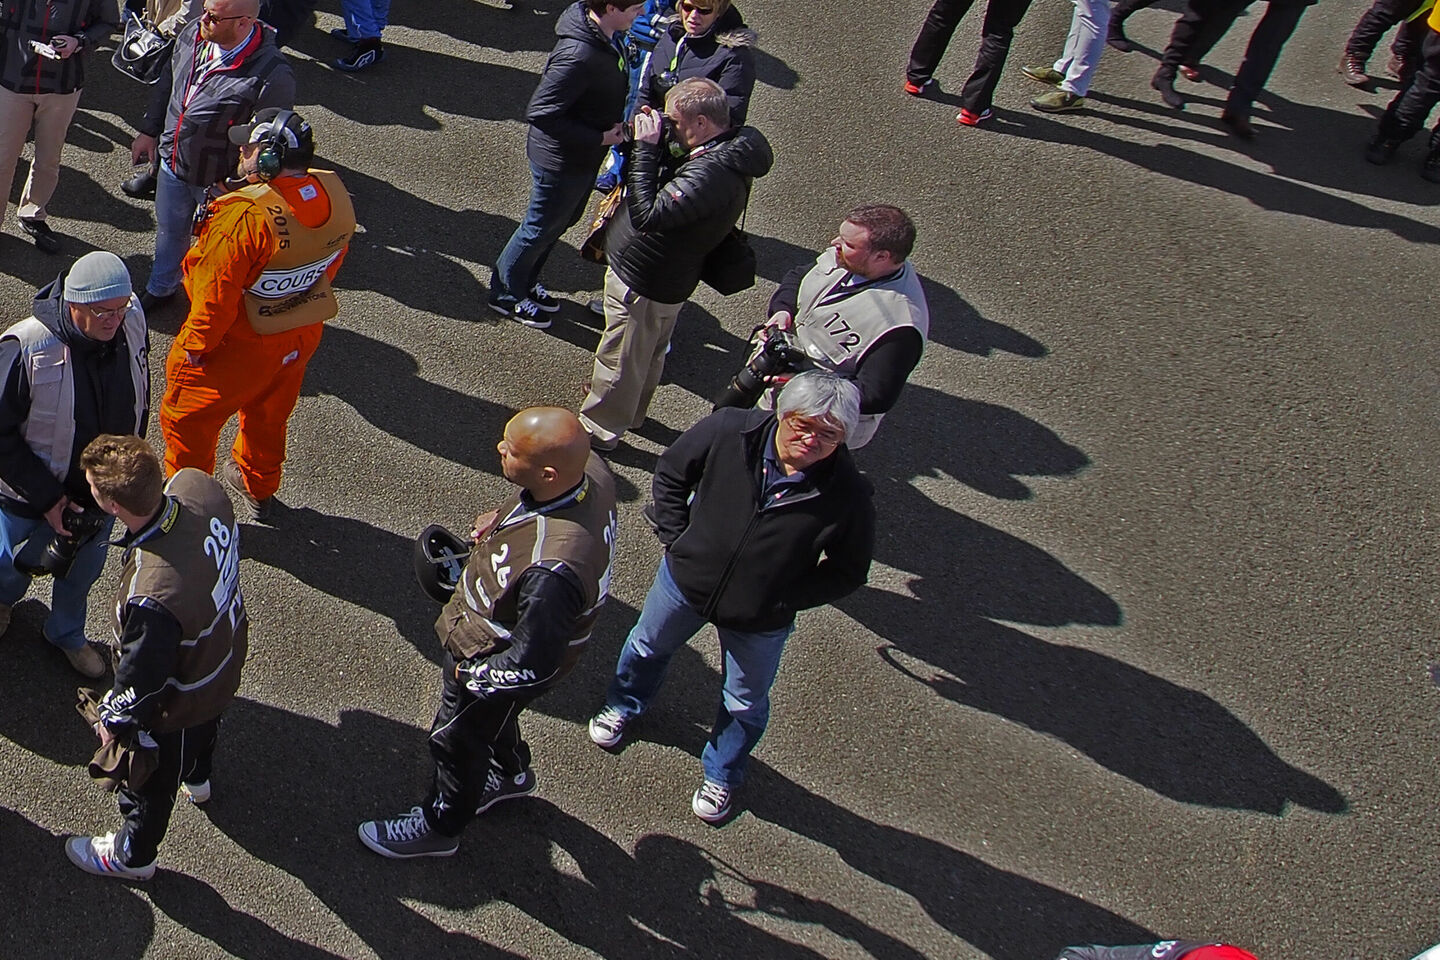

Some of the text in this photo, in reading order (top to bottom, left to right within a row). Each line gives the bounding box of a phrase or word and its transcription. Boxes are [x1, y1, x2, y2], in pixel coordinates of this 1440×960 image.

[265, 205, 291, 250] 2015
[260, 264, 327, 292] COURS
[823, 312, 861, 354] 172
[203, 516, 231, 571] 28
[490, 669, 537, 685] crew
